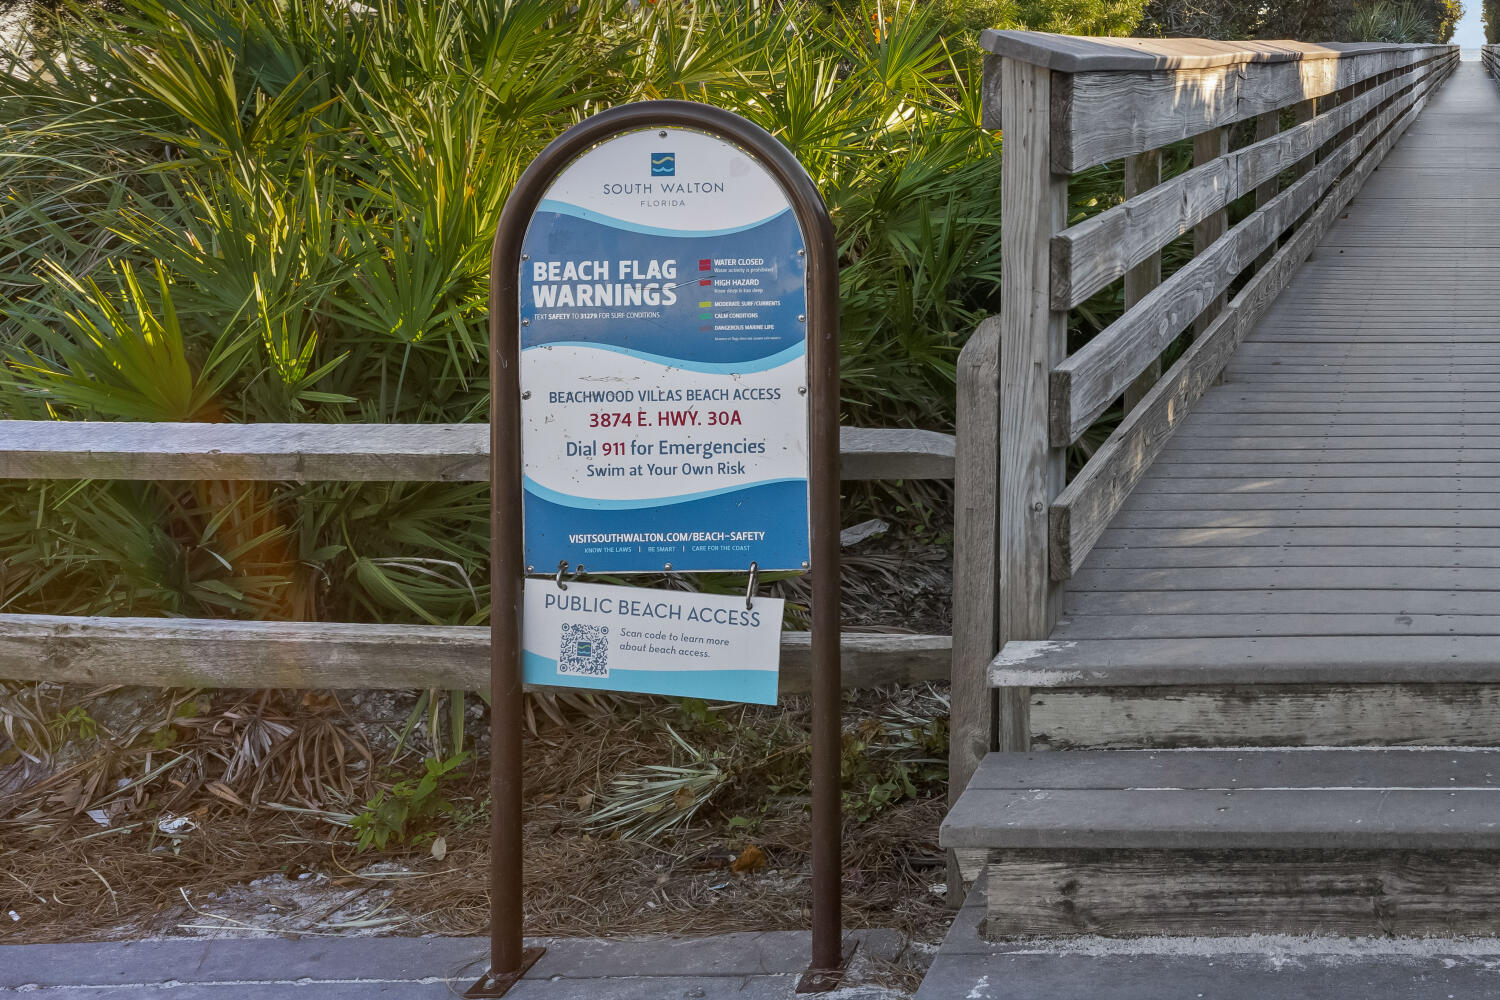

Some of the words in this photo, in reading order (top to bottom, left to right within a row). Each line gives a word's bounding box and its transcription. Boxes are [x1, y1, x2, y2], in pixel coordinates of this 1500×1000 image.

[603, 184, 652, 194] SOUTH
[661, 182, 724, 193] WALTON
[534, 261, 608, 281] BEACH
[619, 260, 677, 280] FLAG
[532, 282, 677, 308] WARNINGS
[549, 390, 634, 403] BEACHWOOD
[638, 390, 682, 401] VILLAS
[686, 389, 728, 401] BEACH
[733, 388, 781, 400] ACCESS
[589, 413, 631, 427] 3874
[638, 412, 651, 427] E.
[658, 411, 701, 426] HWY.
[708, 410, 742, 426] 30A
[566, 440, 597, 456] Dial
[602, 442, 625, 456] 911
[631, 440, 653, 456] for
[659, 438, 765, 459] Emergencies
[587, 464, 624, 476] Swim
[629, 465, 642, 476] at
[647, 463, 677, 476] Your
[682, 463, 713, 475] Own
[718, 461, 745, 475] Risk
[569, 531, 765, 543] VISITSOUTHWALTON.COM/BEACH-SAFETY
[545, 594, 612, 613] PUBLIC
[619, 600, 681, 620] BEACH
[687, 606, 760, 627] ACCESS
[620, 628, 642, 638] Scan
[645, 630, 666, 640] code
[669, 632, 678, 641] to
[681, 632, 704, 644] learn
[706, 637, 730, 646] more
[620, 643, 646, 652] about
[649, 644, 676, 655] beach
[678, 649, 710, 658] access.
